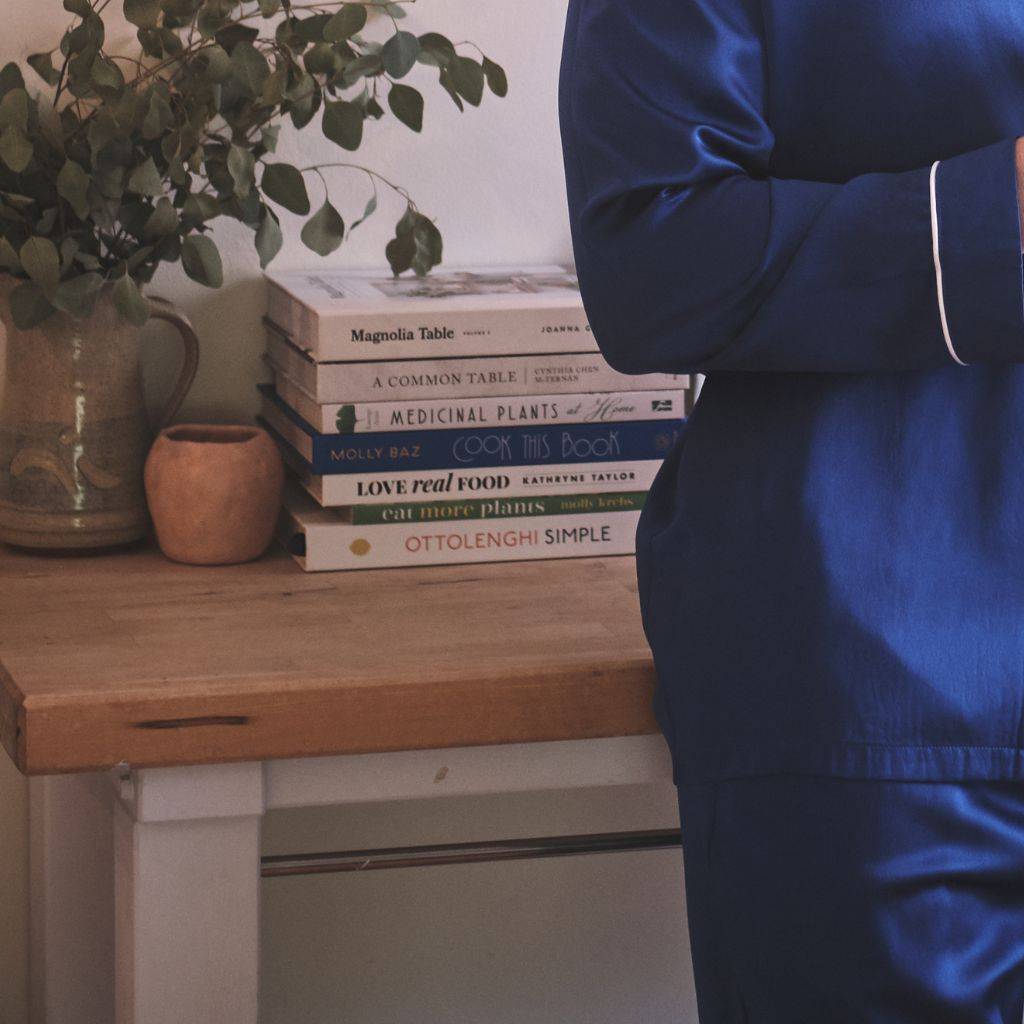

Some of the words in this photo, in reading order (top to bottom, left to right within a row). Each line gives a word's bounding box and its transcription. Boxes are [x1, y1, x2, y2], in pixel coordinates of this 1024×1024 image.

[351, 328, 414, 344] Magnolia
[419, 326, 454, 340] Table
[373, 377, 382, 388] A
[388, 373, 461, 388] COMMON
[467, 370, 517, 384] TABLE
[390, 407, 487, 426] MEDICINAL
[498, 403, 559, 421] PLANTS
[567, 403, 583, 415] at
[584, 396, 637, 423] Home
[331, 447, 383, 461] MOLLY
[390, 445, 421, 458] BAZ
[522, 433, 550, 459] THIS
[357, 479, 407, 496] LOVE
[412, 473, 454, 494] real
[458, 475, 510, 491] FOOD
[523, 475, 585, 484] KATHRYNE
[592, 472, 635, 481] TAYLOR
[382, 508, 413, 521] eat
[421, 504, 474, 519] more
[481, 499, 545, 517] plants
[405, 530, 539, 553] OTTOLENGHI
[545, 526, 611, 545] SIMPLE
